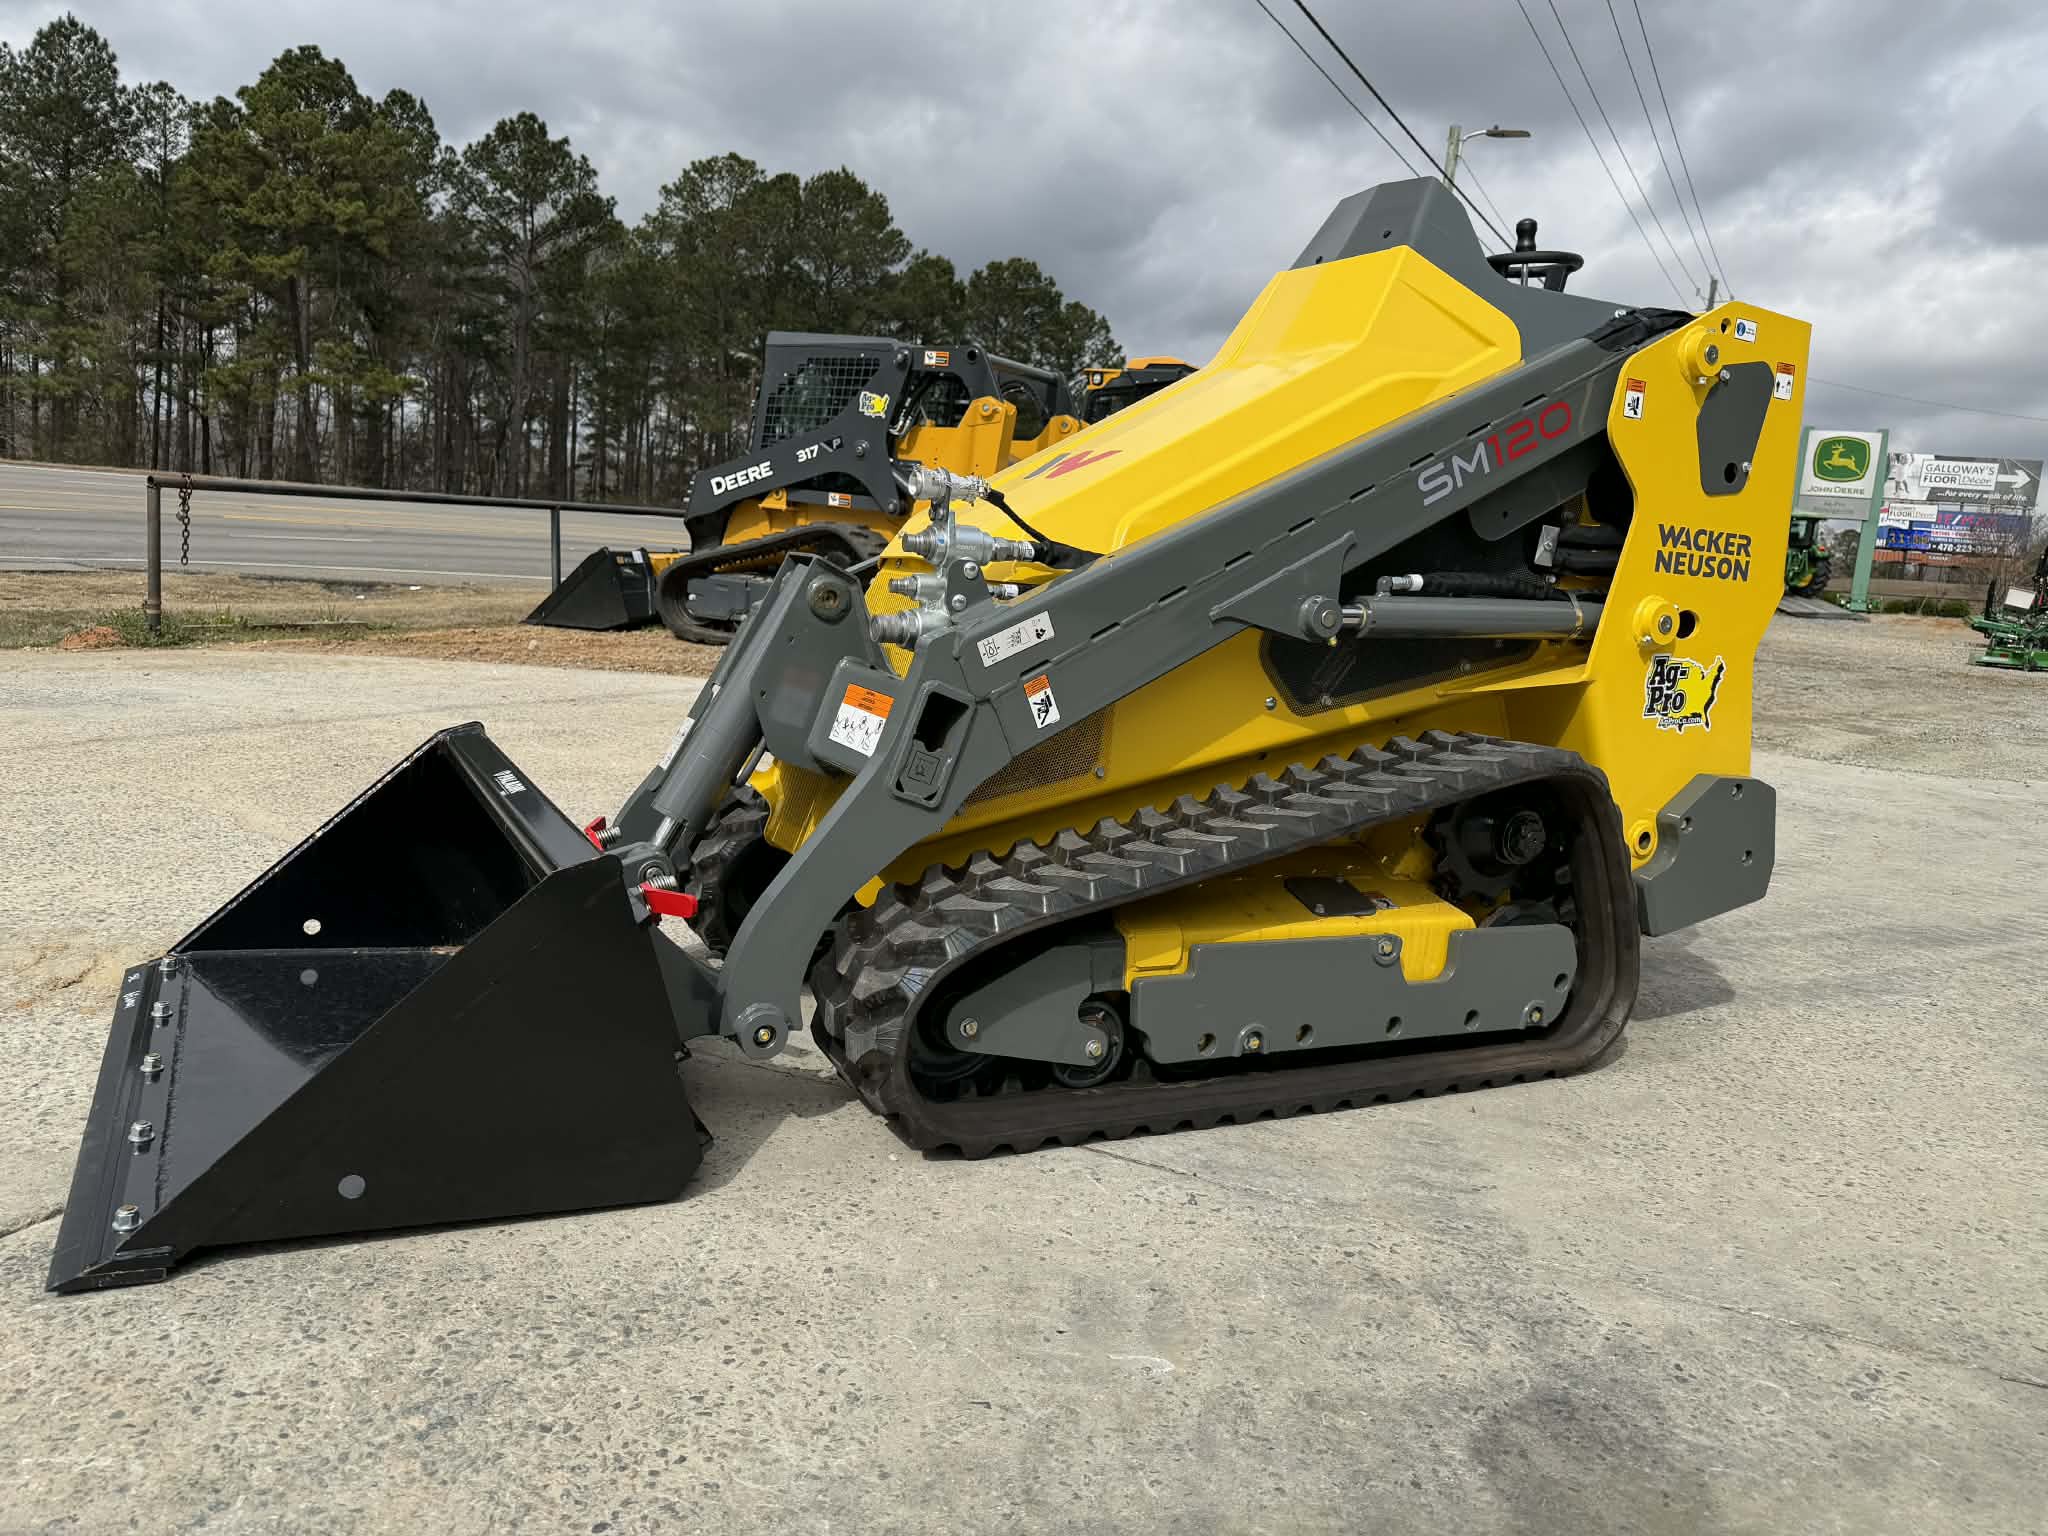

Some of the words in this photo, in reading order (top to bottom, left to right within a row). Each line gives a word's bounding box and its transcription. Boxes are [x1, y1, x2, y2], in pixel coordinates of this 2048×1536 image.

[796, 444, 820, 463] 317
[1417, 401, 1573, 506] SM120
[1925, 463, 1996, 476] GALLOWAY'S
[710, 460, 774, 496] DEERE
[1807, 485, 1833, 494] JOHN
[1833, 487, 1865, 496] DEERE
[1923, 475, 1957, 485] FLOOR
[1658, 523, 1752, 558] WACKER
[1654, 549, 1751, 583] NEUSON
[1648, 655, 1688, 690] Ag-
[1644, 686, 1686, 717] Pro
